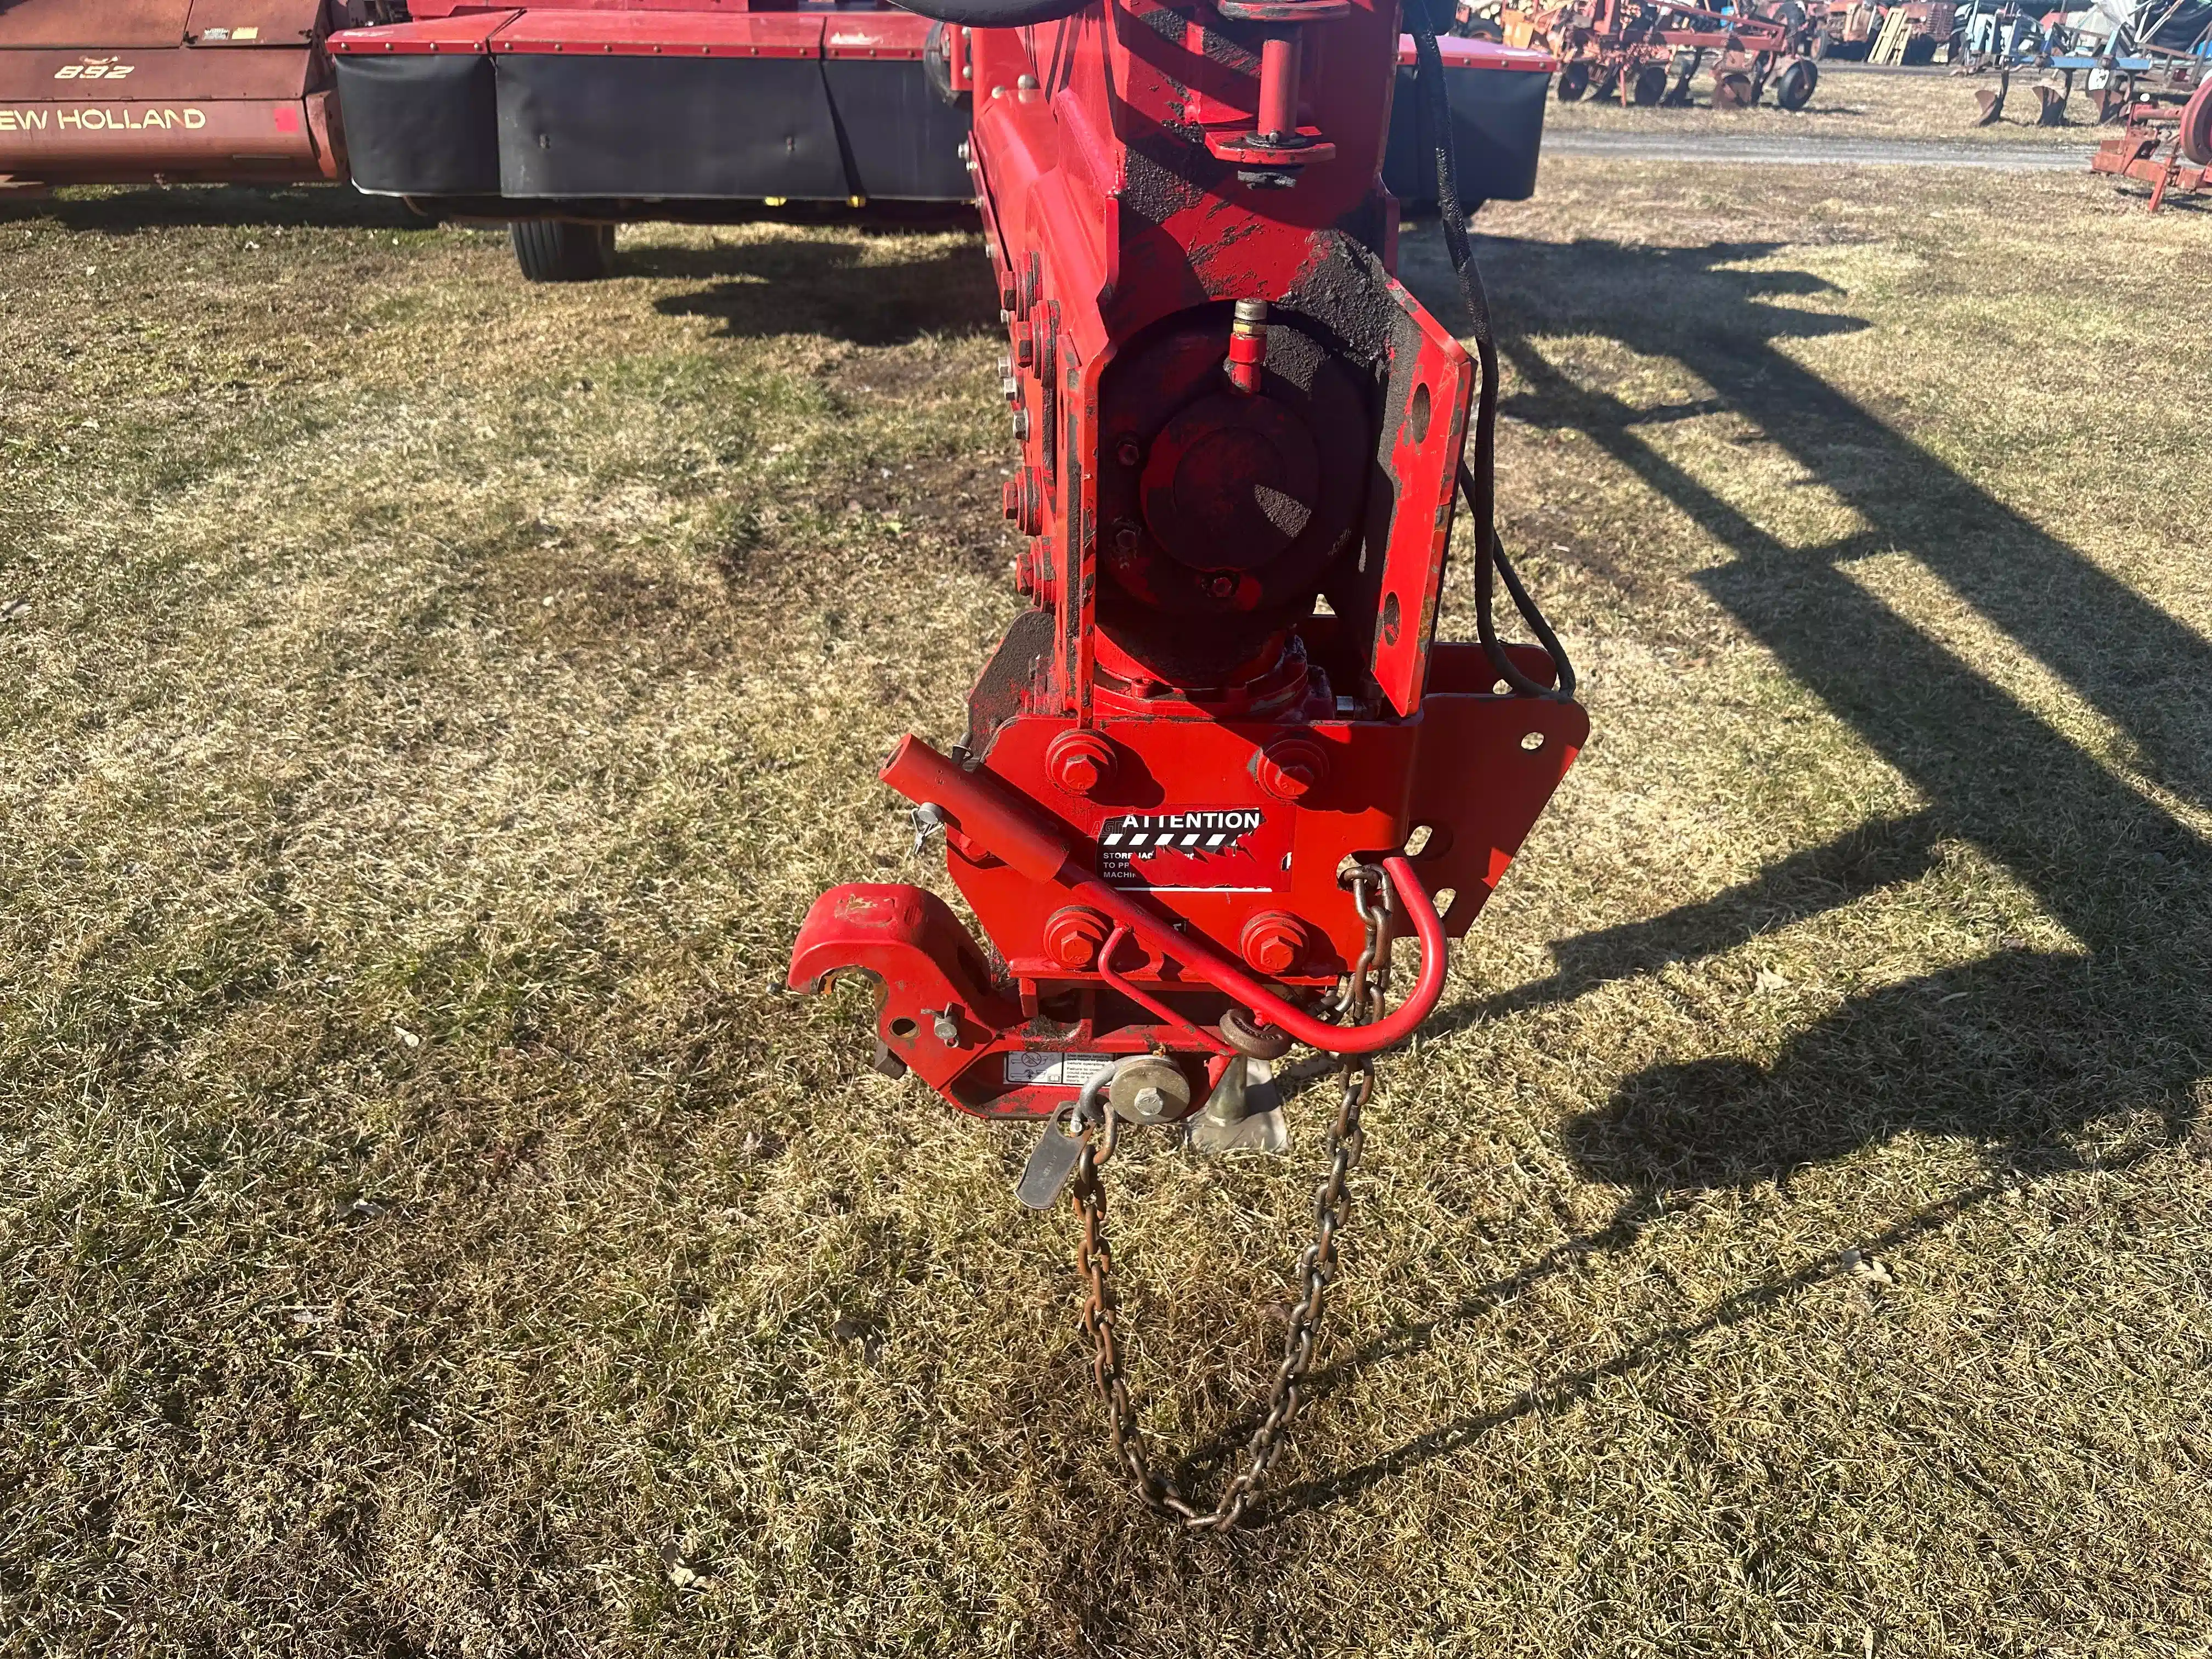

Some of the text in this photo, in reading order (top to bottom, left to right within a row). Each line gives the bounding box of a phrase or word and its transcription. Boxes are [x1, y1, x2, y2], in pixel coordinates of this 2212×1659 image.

[54, 65, 135, 79] 892
[0, 109, 206, 131] EW HOLLAND
[1122, 812, 1260, 829] ATTENTION
